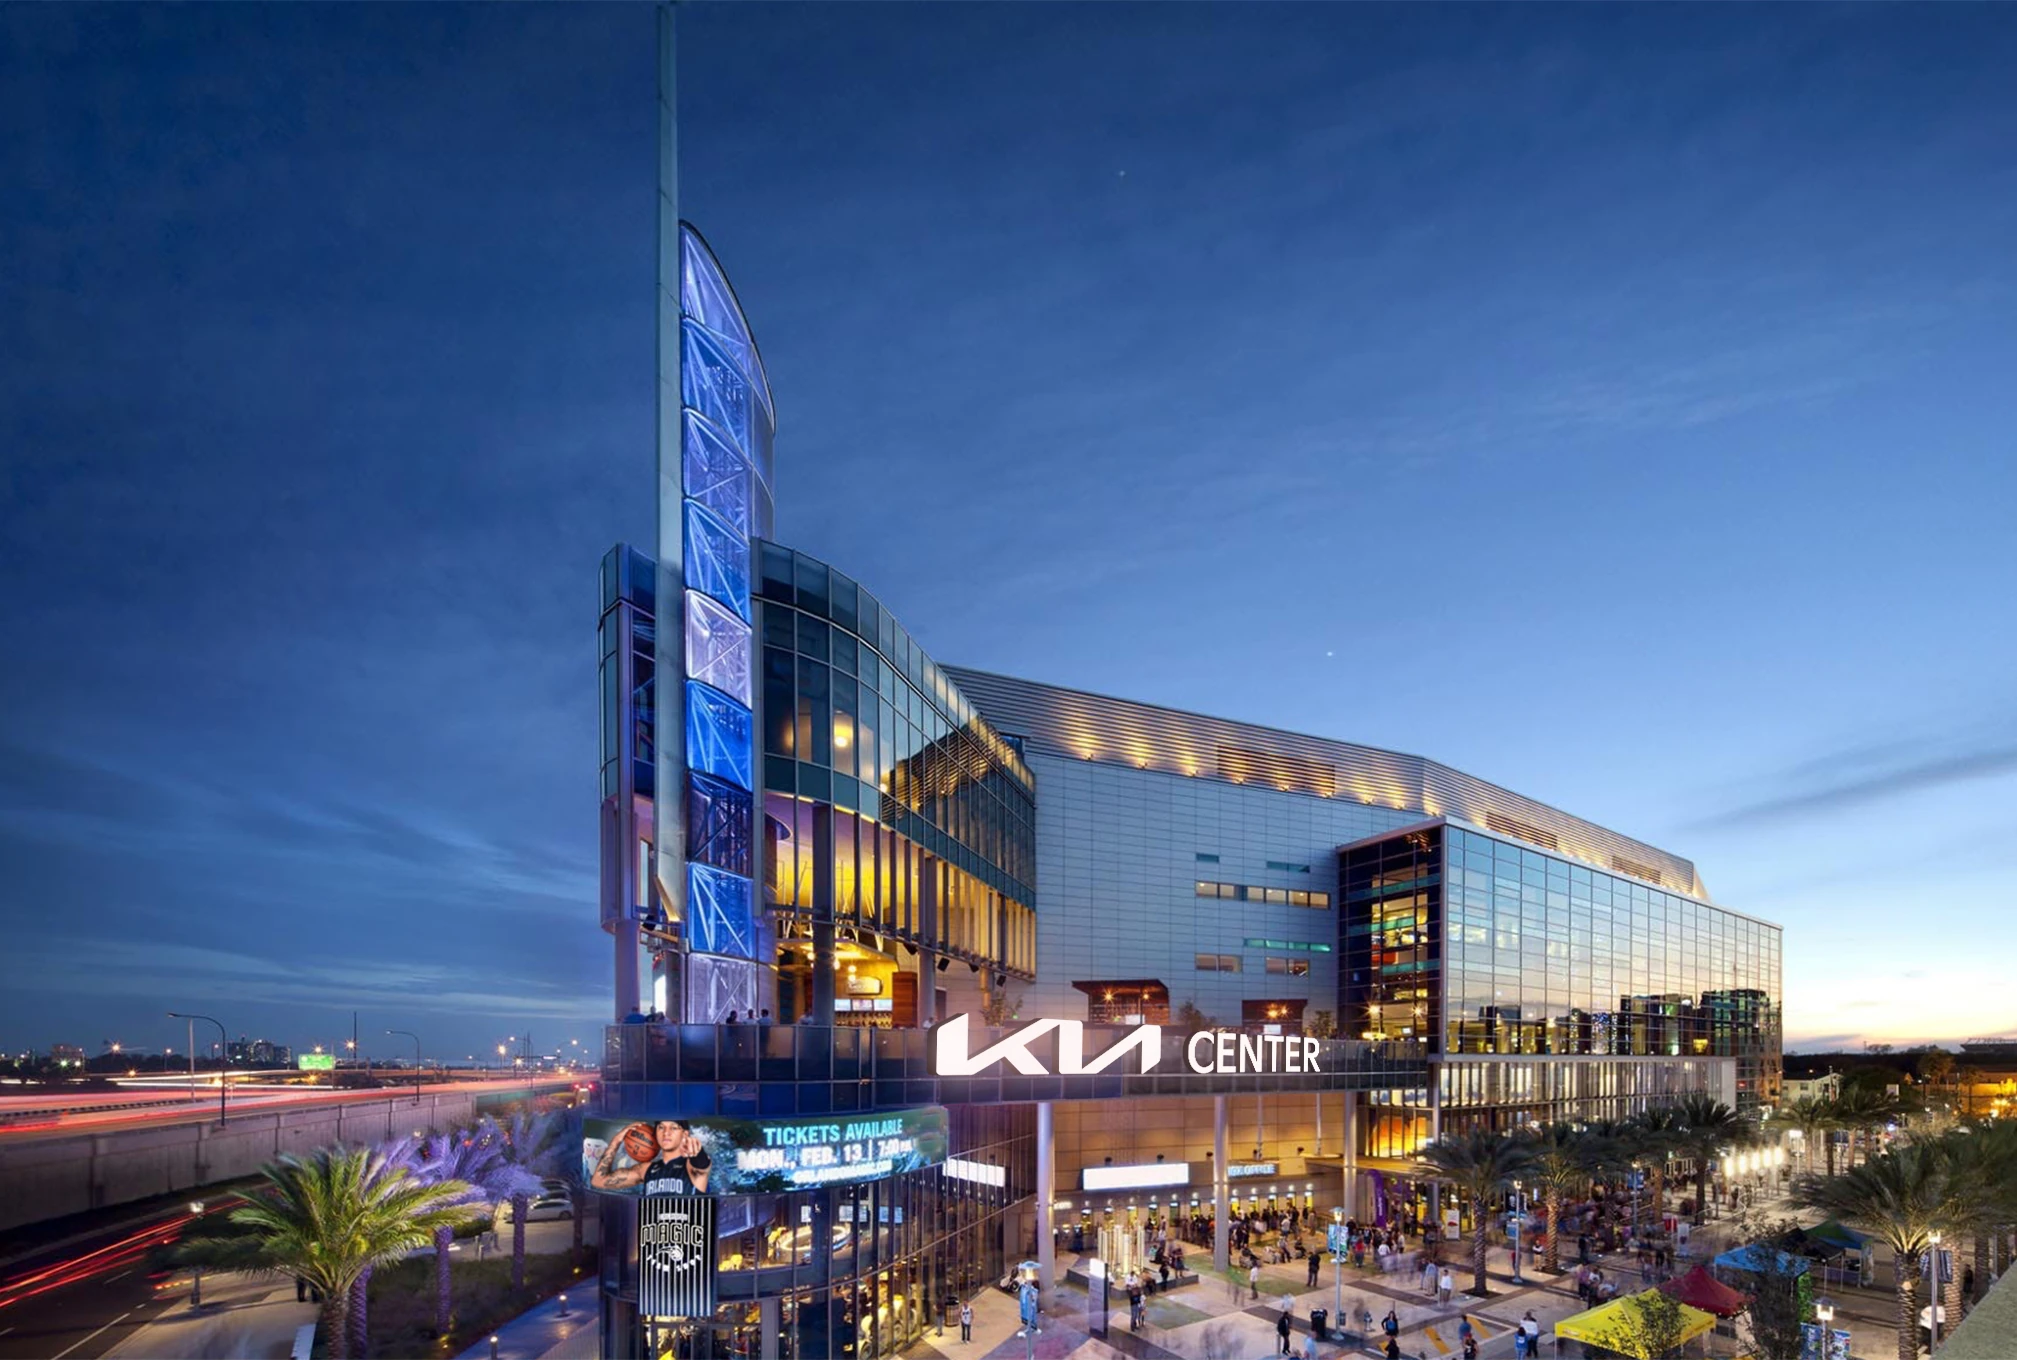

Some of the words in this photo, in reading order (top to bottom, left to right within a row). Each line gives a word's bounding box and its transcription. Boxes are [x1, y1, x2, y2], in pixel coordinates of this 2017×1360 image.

[936, 1013, 1161, 1075] KIA
[1187, 1031, 1321, 1074] CENTER
[763, 1125, 840, 1146] TICKETS
[845, 1118, 903, 1141] AVAILABLE
[843, 1143, 862, 1162] 13
[641, 1222, 704, 1248] MAGIC
